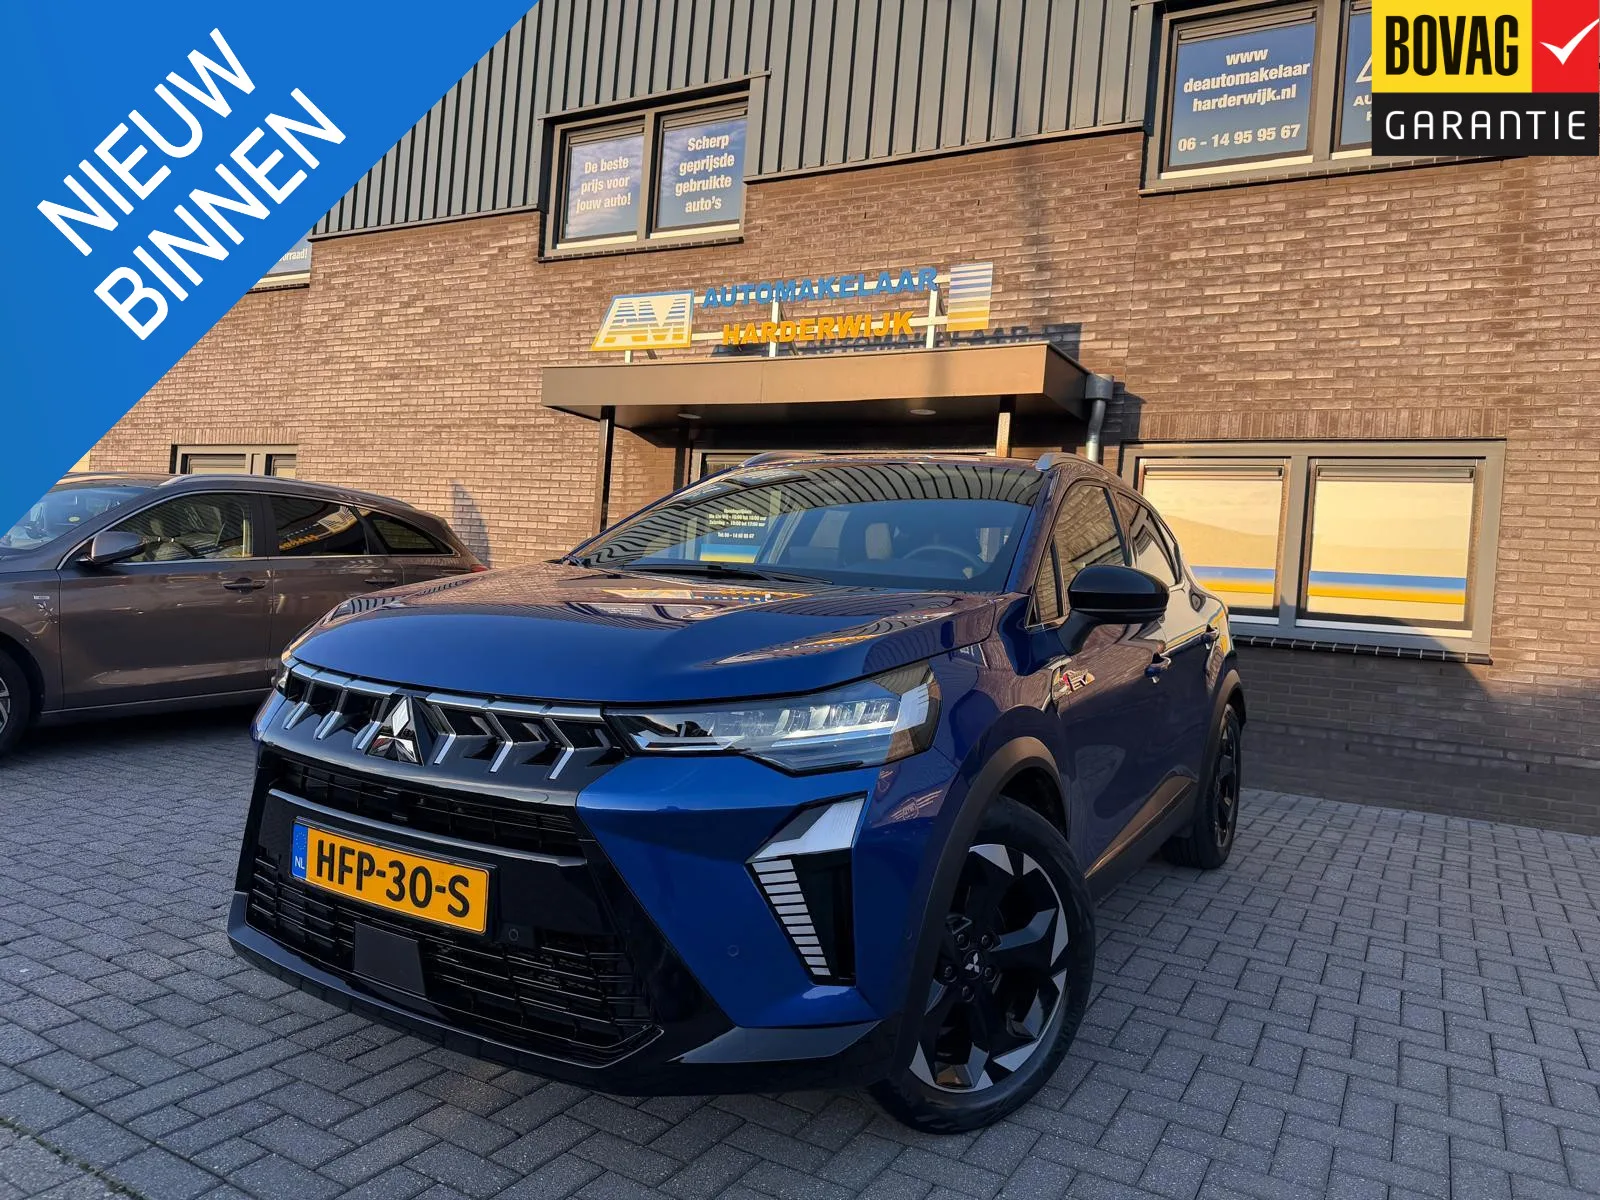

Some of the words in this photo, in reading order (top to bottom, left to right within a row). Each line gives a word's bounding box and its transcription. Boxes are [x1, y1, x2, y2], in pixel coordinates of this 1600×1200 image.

[1225, 49, 1269, 66] www
[1183, 63, 1311, 93] deautomakelaar
[1192, 84, 1297, 112] harderwijk.nl
[687, 134, 730, 151] Scherp
[1177, 137, 1197, 152] 06
[1211, 132, 1230, 148] 14
[1233, 130, 1253, 145] 95
[1257, 127, 1277, 142] 95
[1280, 123, 1301, 139] 67
[584, 161, 598, 174] De
[600, 156, 629, 172] beste
[679, 153, 735, 176] geprijsde
[581, 179, 604, 194] prijs
[606, 175, 631, 190] voor
[675, 175, 732, 196] gebruikte
[604, 193, 631, 208] auto!
[685, 196, 722, 213] auto's
[702, 267, 939, 309] AUTOMAKELAAR
[722, 311, 915, 346] HARDERWIJK
[294, 856, 305, 870] NL
[316, 839, 470, 918] HFP-30-S
